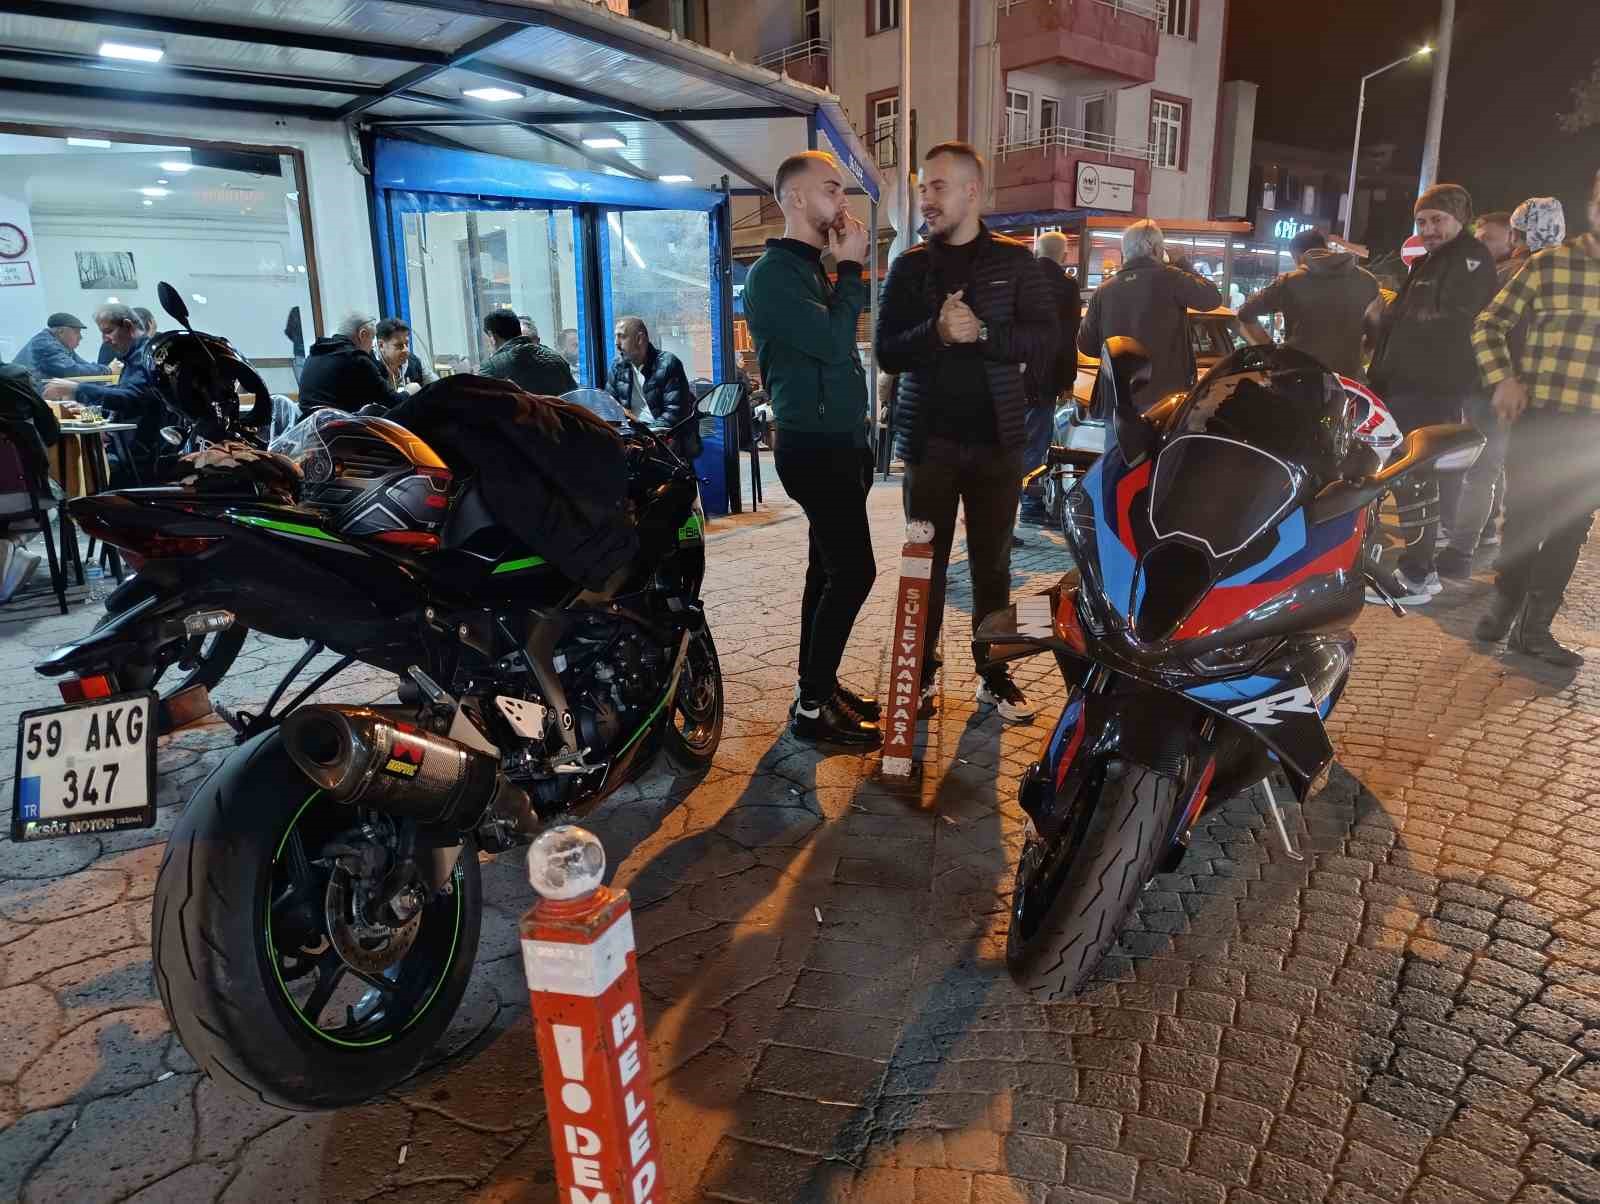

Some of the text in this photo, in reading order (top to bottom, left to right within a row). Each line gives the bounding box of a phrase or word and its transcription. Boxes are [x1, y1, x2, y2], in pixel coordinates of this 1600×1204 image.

[1227, 685, 1316, 725] RR
[26, 705, 144, 761] 59 AKG
[62, 762, 119, 809] 347
[24, 804, 37, 817] TR
[70, 818, 115, 833] MOTOR
[611, 1002, 656, 1204] BELED
